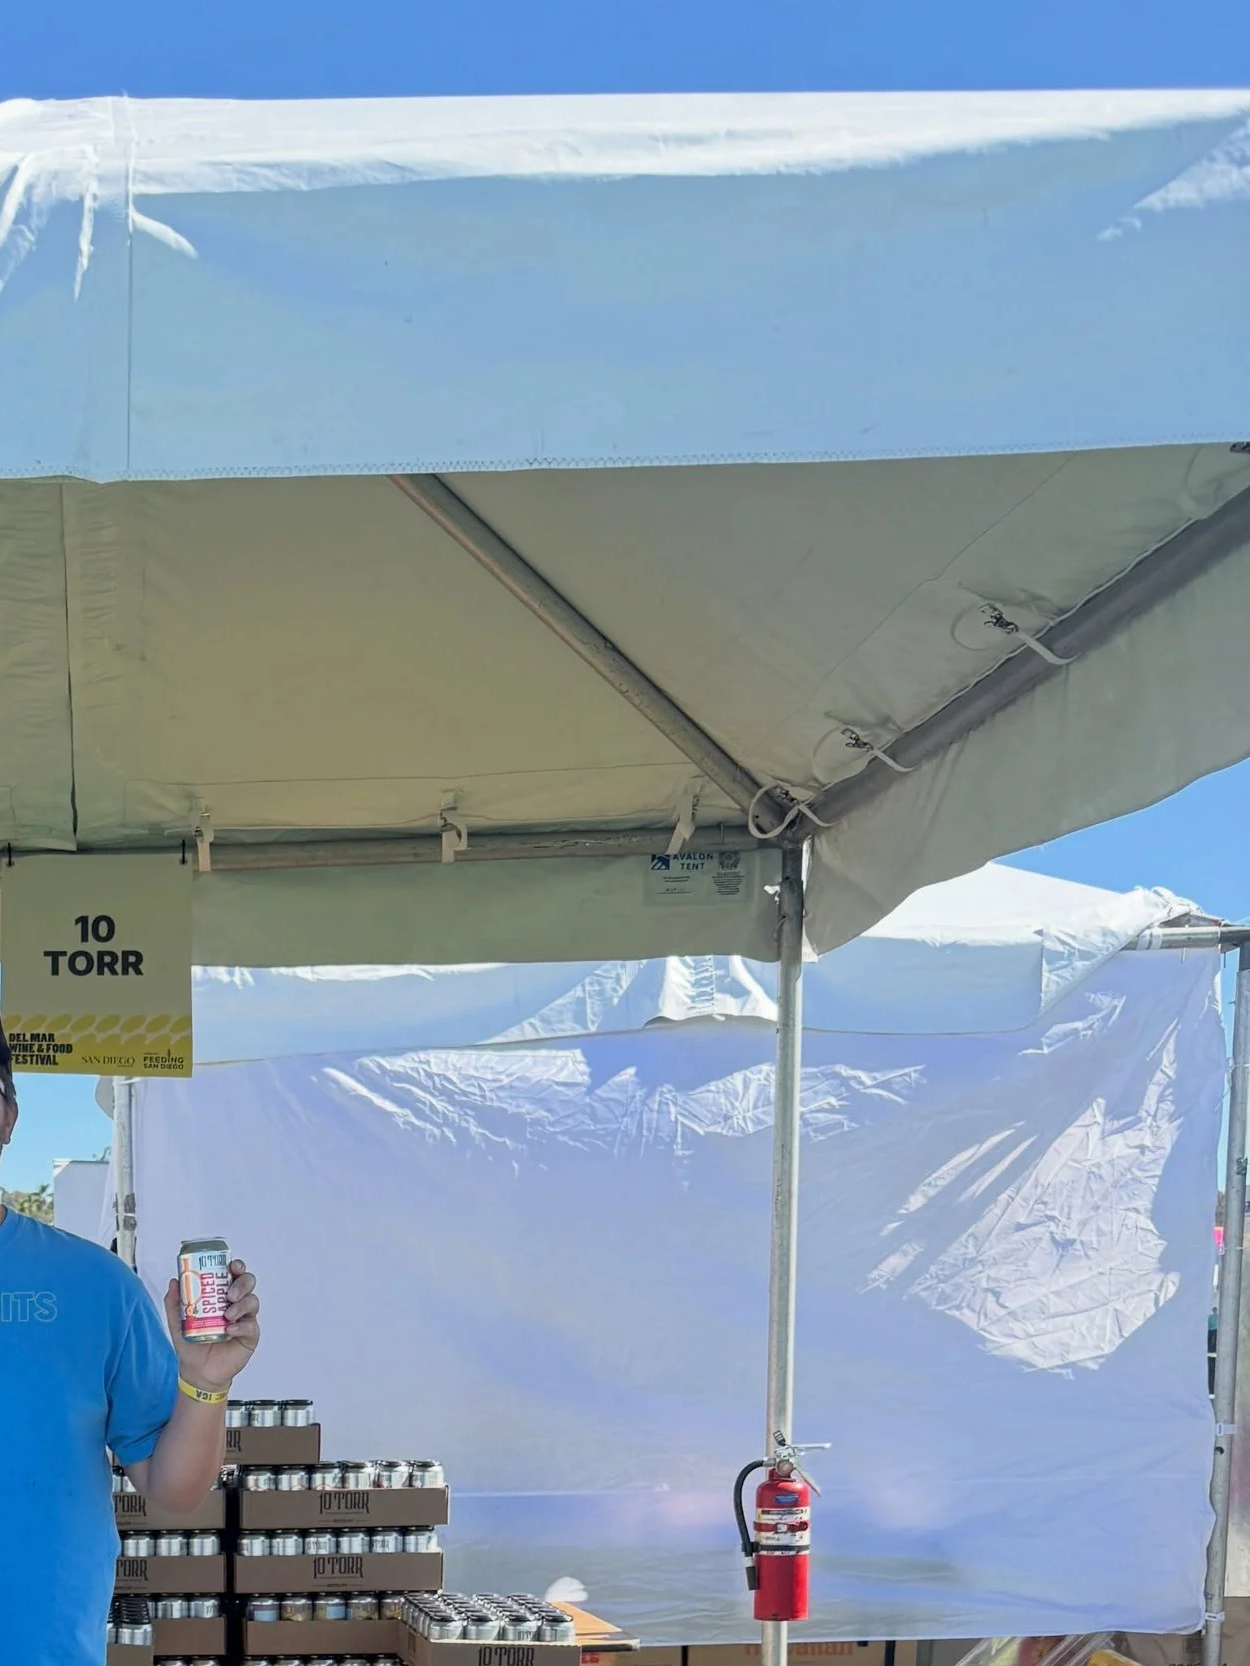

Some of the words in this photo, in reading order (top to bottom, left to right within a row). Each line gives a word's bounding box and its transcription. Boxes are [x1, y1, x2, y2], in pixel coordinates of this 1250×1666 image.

[672, 852, 714, 860] AVALON
[74, 914, 116, 943] 10
[43, 950, 144, 976] TORR
[9, 1033, 28, 1042] DEL
[30, 1033, 55, 1042] MAR
[9, 1043, 35, 1053] WINE
[36, 1044, 45, 1053] &
[46, 1043, 73, 1053] FOOD
[10, 1054, 59, 1066] FESTIVAL
[81, 1056, 100, 1064] SAN
[143, 1053, 185, 1064] FEEDING
[200, 1272, 216, 1314] SPICED
[319, 1491, 332, 1514] 10
[334, 1491, 370, 1514] TORR
[313, 1556, 325, 1579] 10
[327, 1556, 364, 1578] TORR
